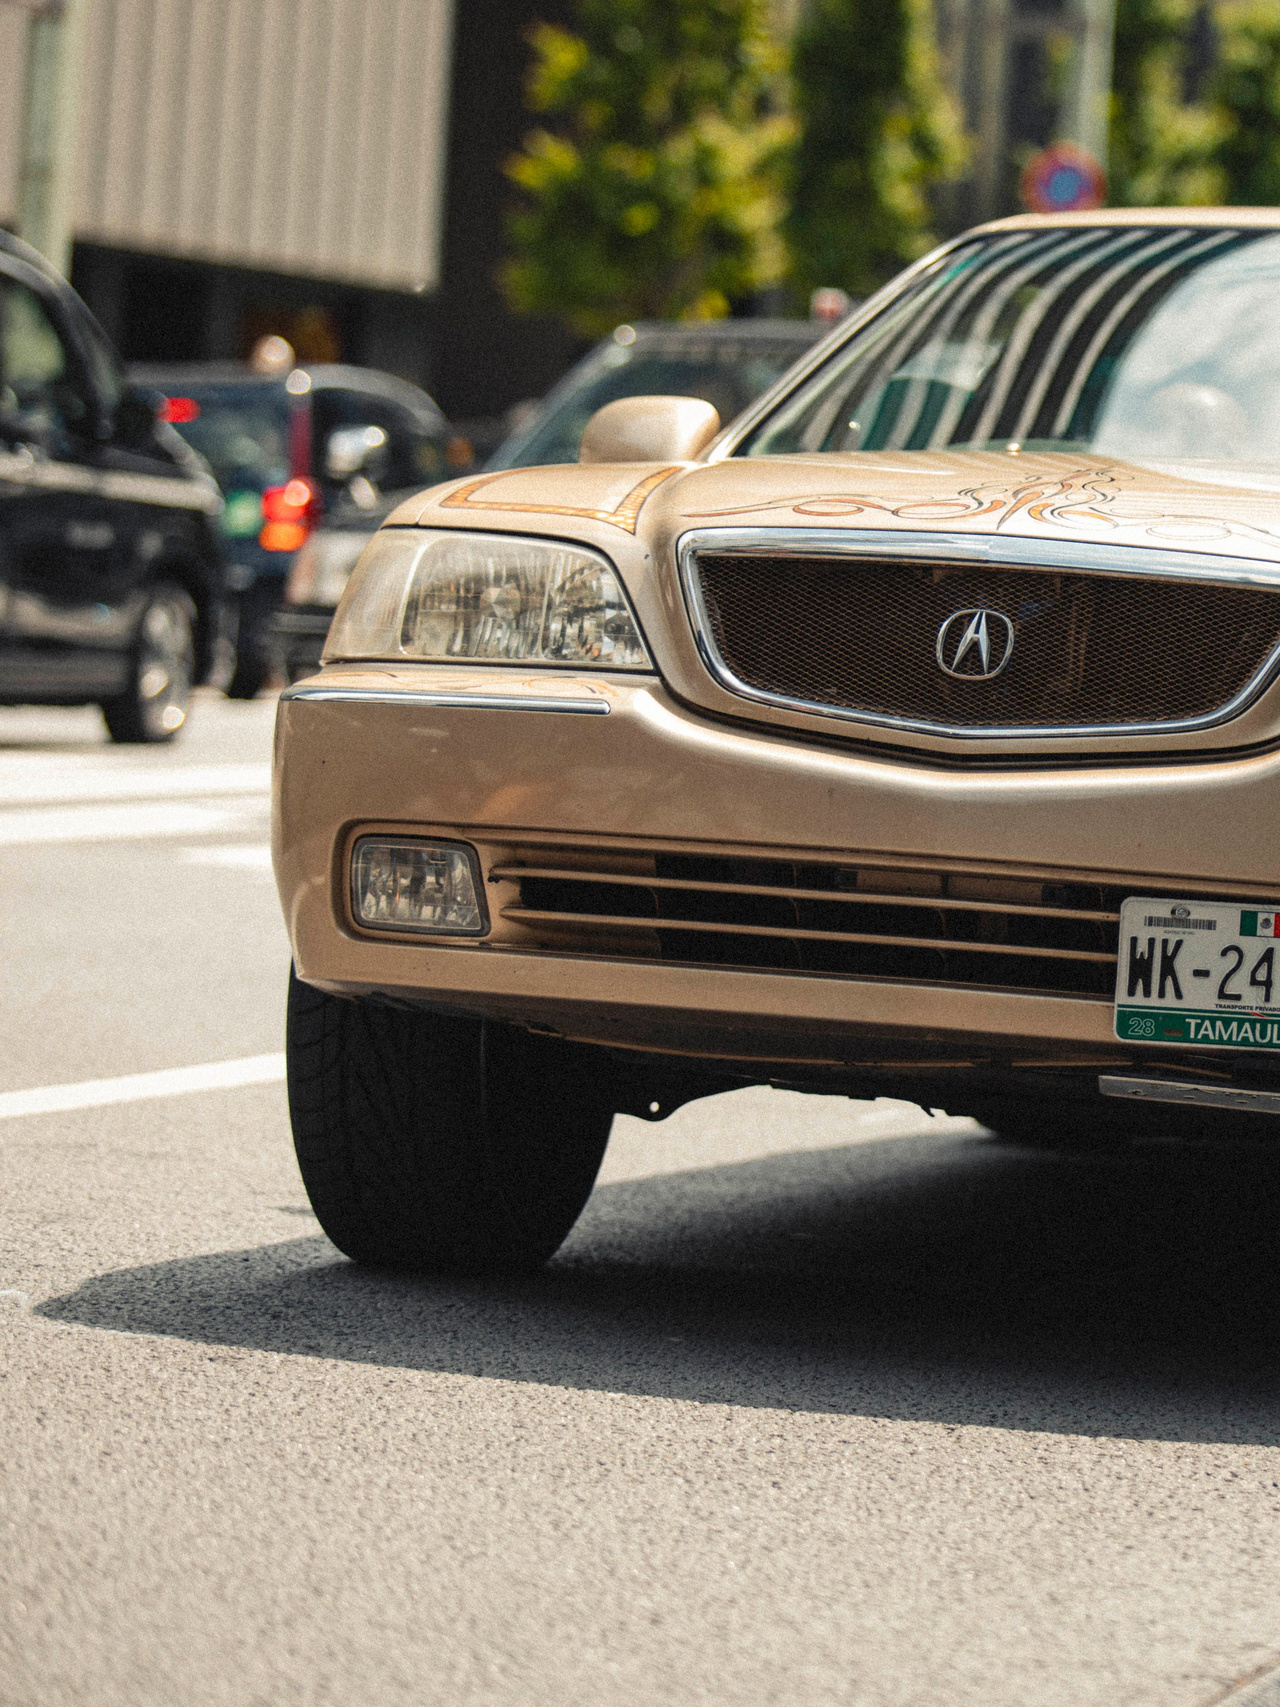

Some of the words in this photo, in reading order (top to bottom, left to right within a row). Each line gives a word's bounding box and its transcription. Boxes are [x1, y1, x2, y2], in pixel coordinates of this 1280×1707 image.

[1214, 1003, 1254, 1011] TRANSPORTE
[1255, 1005, 1280, 1013] PRIVADO
[1127, 1018, 1156, 1037] 28
